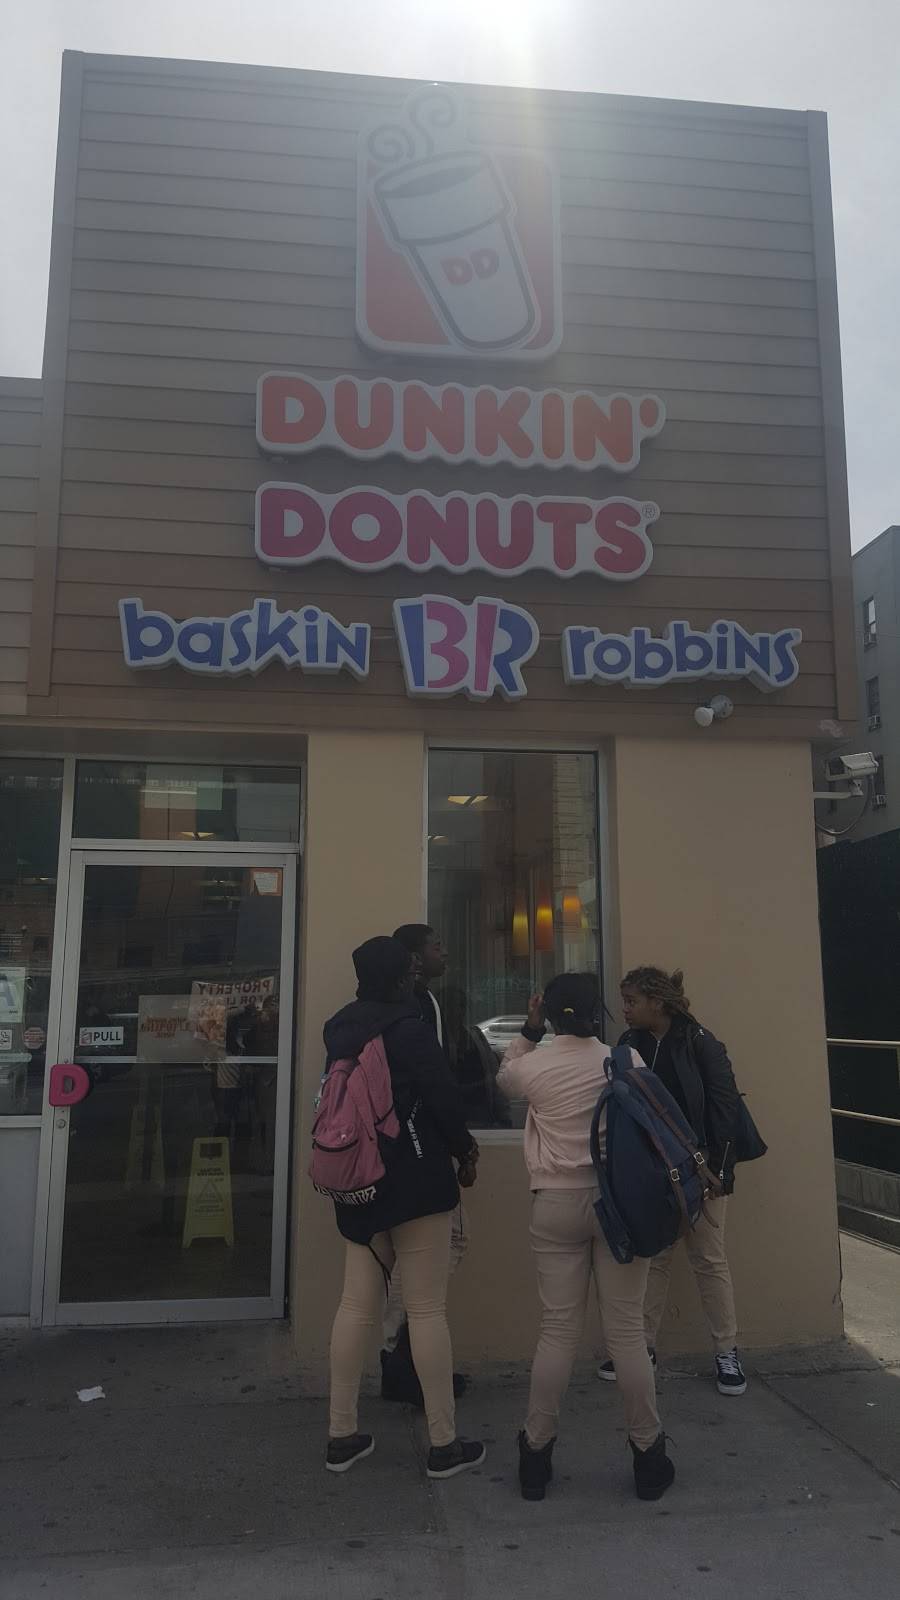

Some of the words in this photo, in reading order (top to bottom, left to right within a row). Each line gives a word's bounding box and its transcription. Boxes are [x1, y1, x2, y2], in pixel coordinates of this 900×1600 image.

[440, 247, 499, 286] DD
[261, 375, 660, 464] DUNKIN'
[260, 487, 647, 573] DONUTS
[400, 599, 534, 693] BR
[93, 1031, 122, 1042] PULL
[49, 1063, 90, 1107] D
